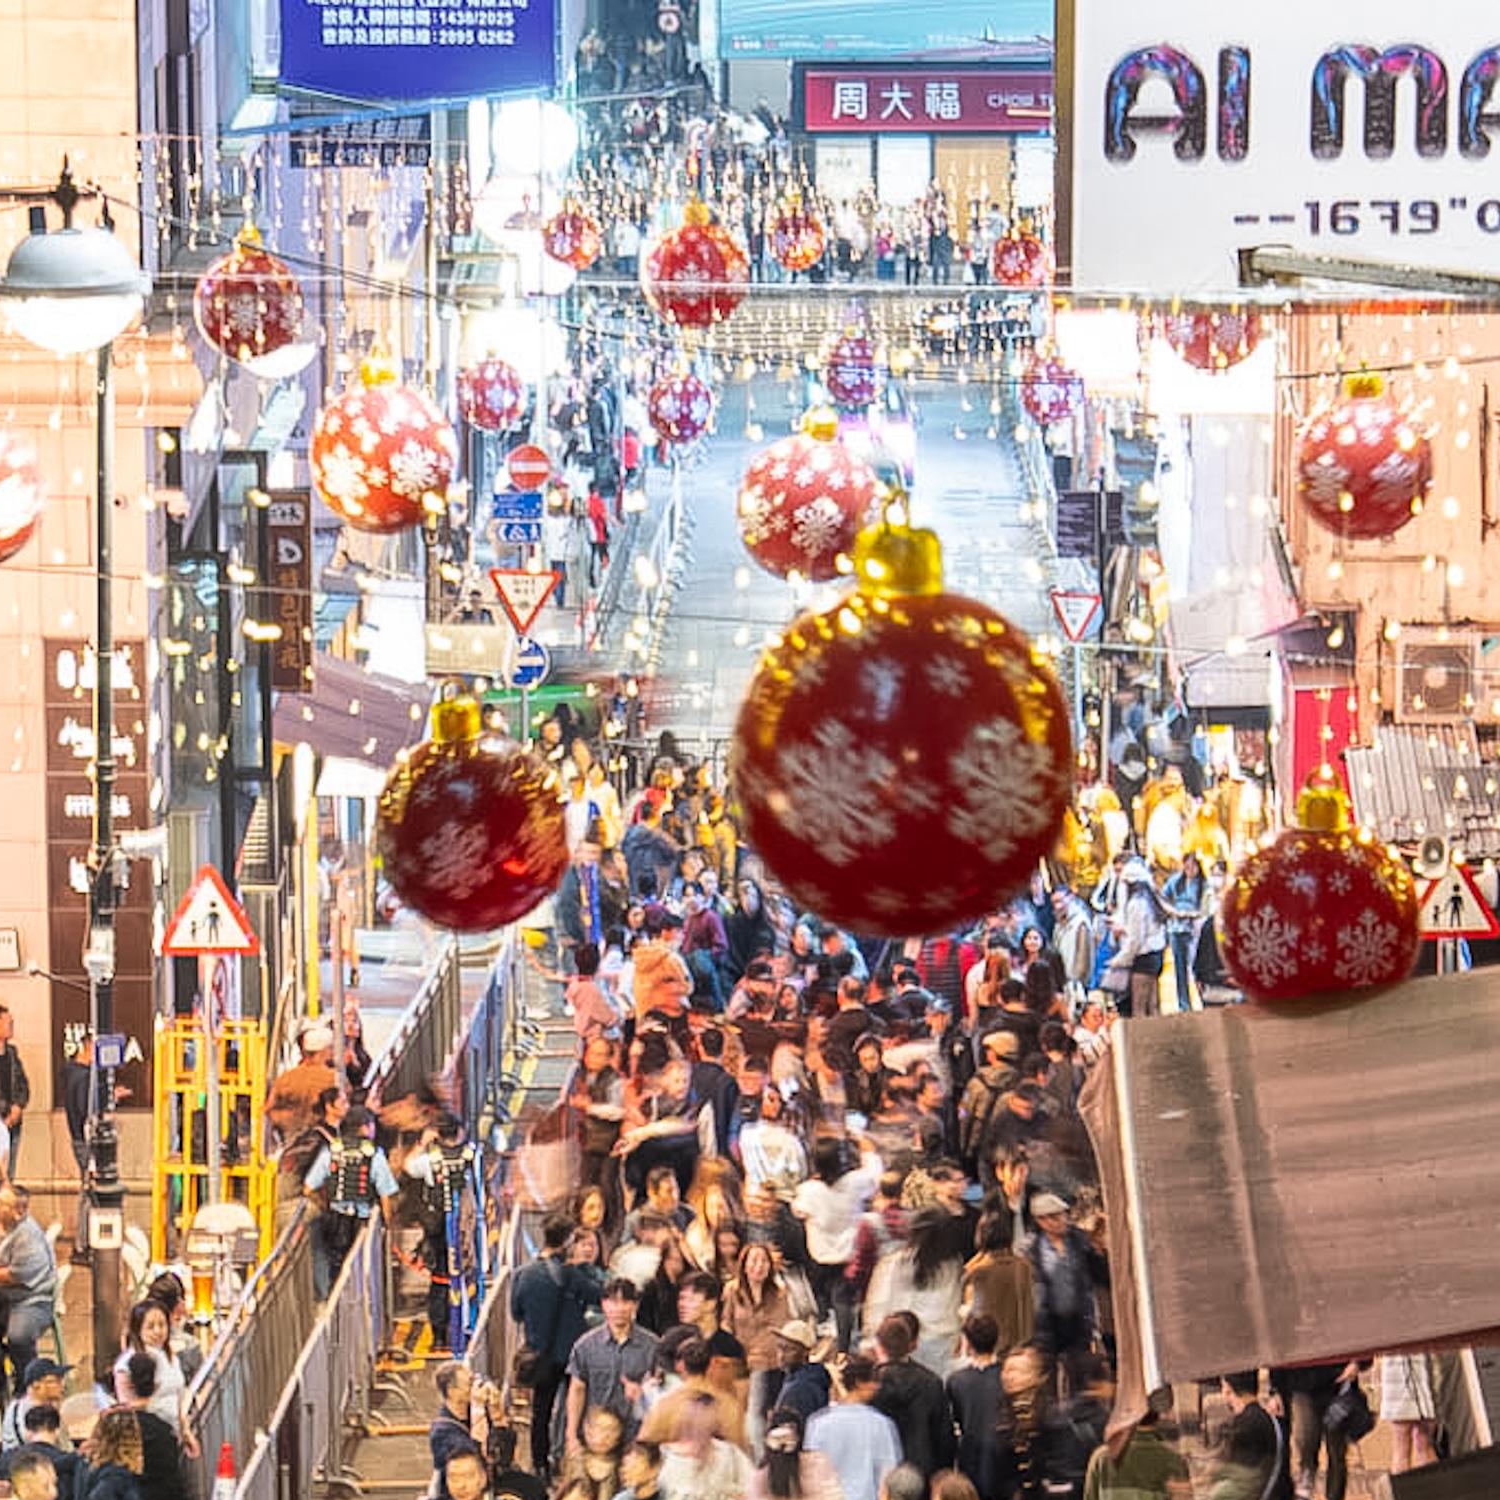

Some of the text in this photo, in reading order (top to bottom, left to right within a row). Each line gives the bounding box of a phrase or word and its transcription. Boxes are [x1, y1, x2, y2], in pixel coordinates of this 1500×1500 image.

[831, 81, 961, 120] 周大福
[1103, 42, 1251, 162] AI
